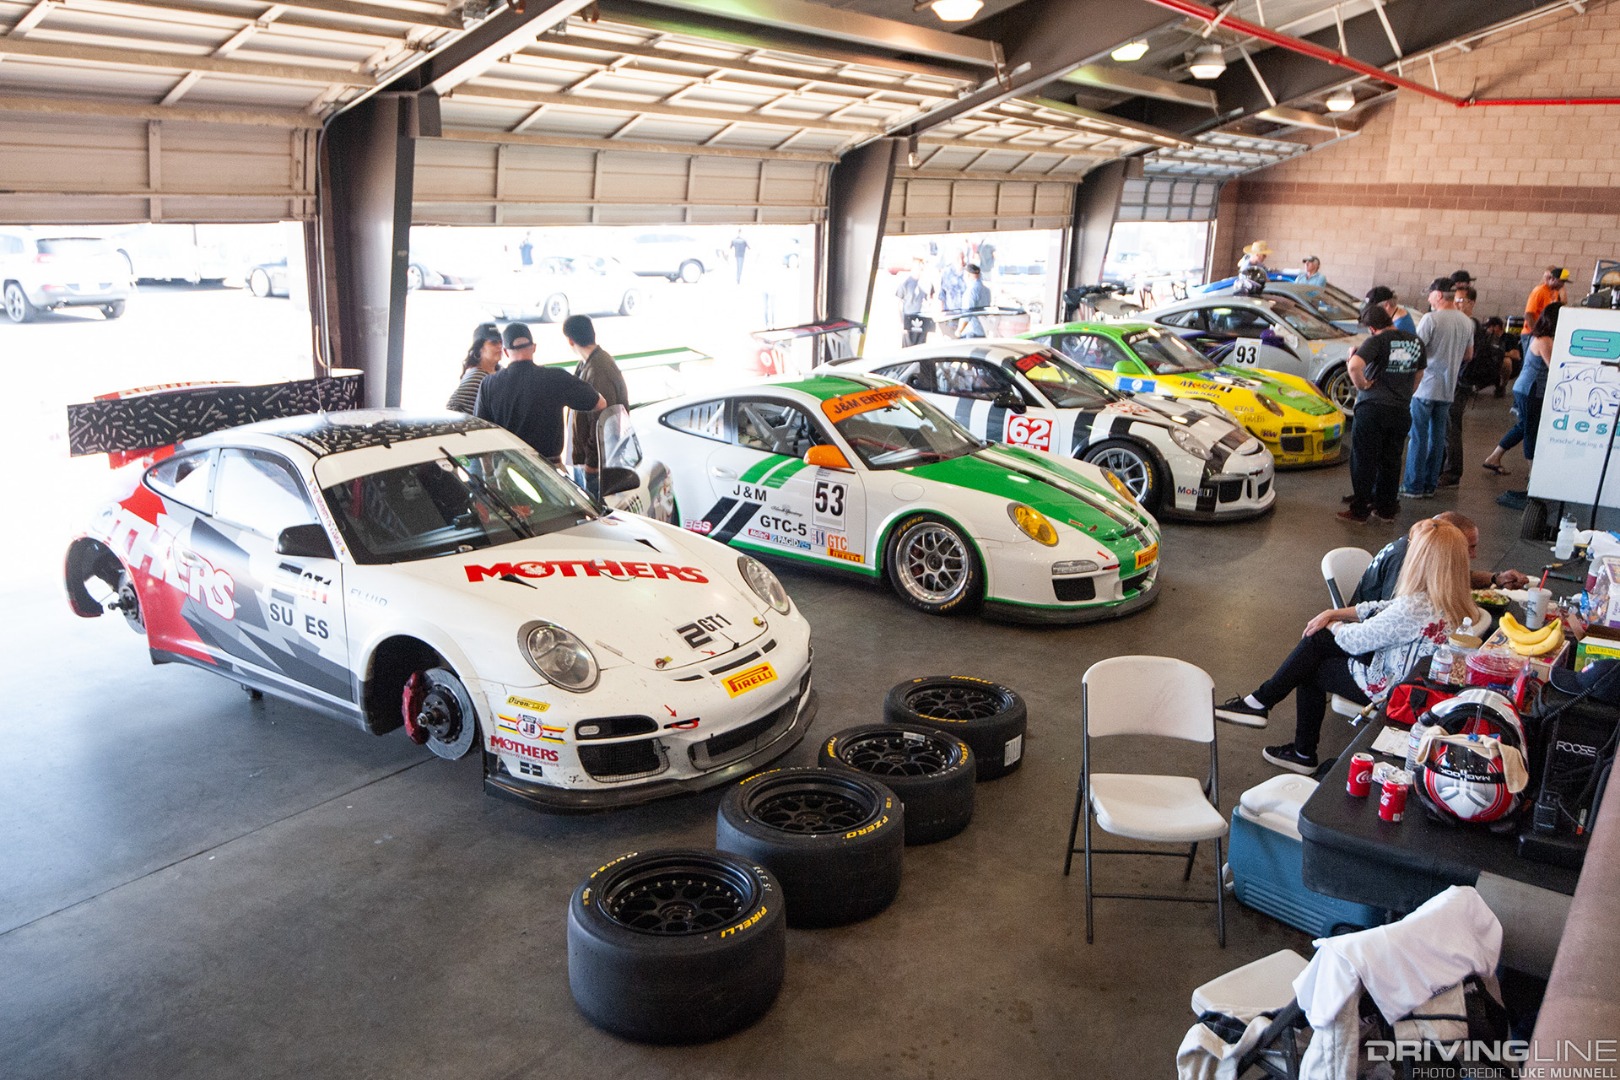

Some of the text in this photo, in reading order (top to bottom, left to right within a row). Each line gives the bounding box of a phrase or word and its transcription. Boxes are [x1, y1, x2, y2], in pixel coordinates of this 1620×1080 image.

[1236, 345, 1256, 364] 93
[834, 400, 861, 414] J&M
[1009, 417, 1050, 446] 62
[815, 481, 844, 516] 53
[684, 520, 712, 534] BBS
[760, 514, 807, 537] GTC-5
[827, 534, 847, 551] GTC
[464, 560, 709, 584] MOTHERS
[676, 613, 732, 649] 2 GT1
[727, 665, 773, 693] PIRELLI
[490, 735, 559, 762] MOTHERS
[1556, 740, 1596, 757] FOOSE
[721, 905, 768, 938] PIRELLI
